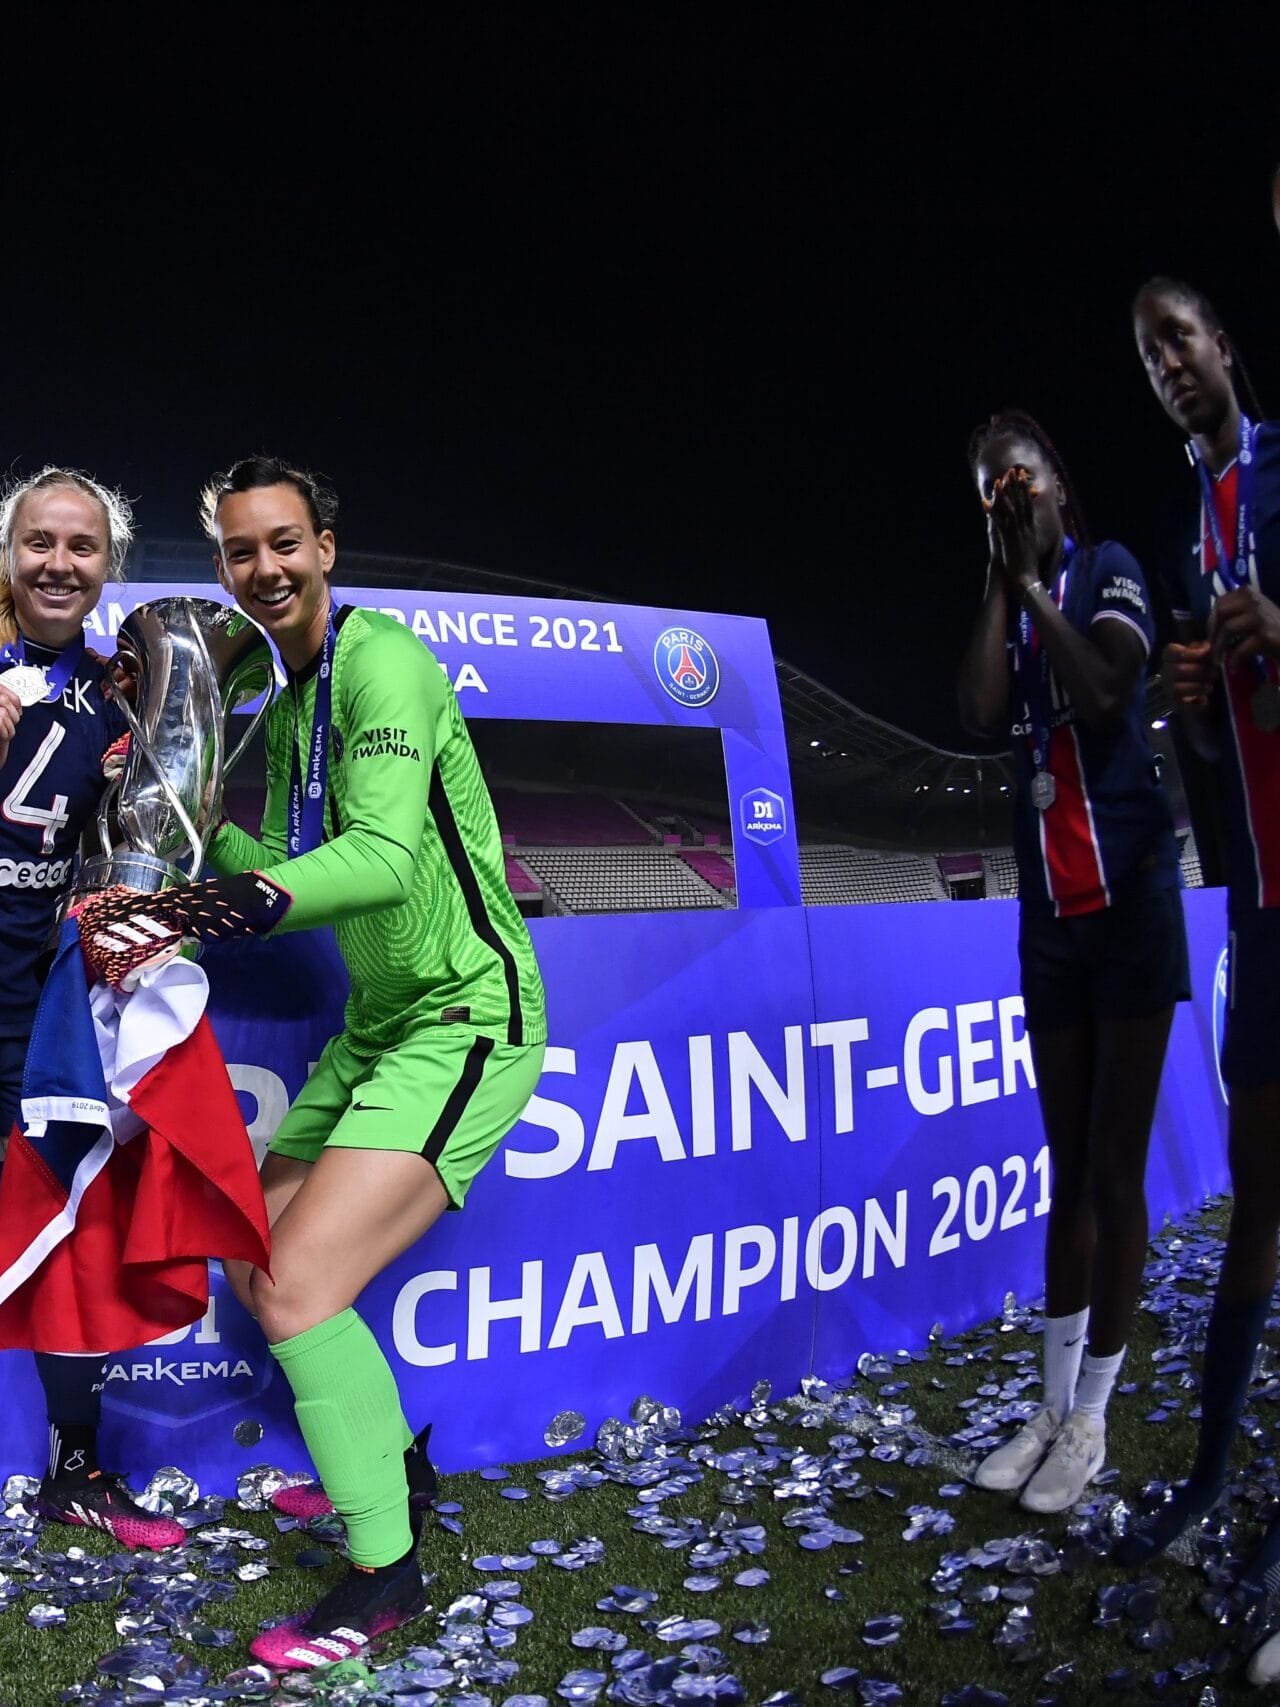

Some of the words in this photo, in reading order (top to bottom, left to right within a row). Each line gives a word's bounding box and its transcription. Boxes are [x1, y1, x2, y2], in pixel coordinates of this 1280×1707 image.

[1112, 576, 1141, 595] VISIT
[360, 607, 518, 647] ANCE
[528, 615, 623, 653] 2021
[662, 631, 704, 652] PARIS
[363, 727, 408, 744] VISIT
[311, 724, 323, 781] ARKEMA
[352, 742, 420, 762] RWANDA
[2, 720, 69, 855] 4
[291, 784, 301, 837] ARKEMA
[752, 800, 773, 819] D1
[746, 821, 782, 832] ARKEMA
[505, 994, 1037, 1180] SAINT-GER
[72, 1101, 89, 1110] 2019
[391, 1191, 909, 1368] CHAMPION
[928, 1145, 1052, 1257] 2021
[105, 1357, 254, 1386] ARKEMA
